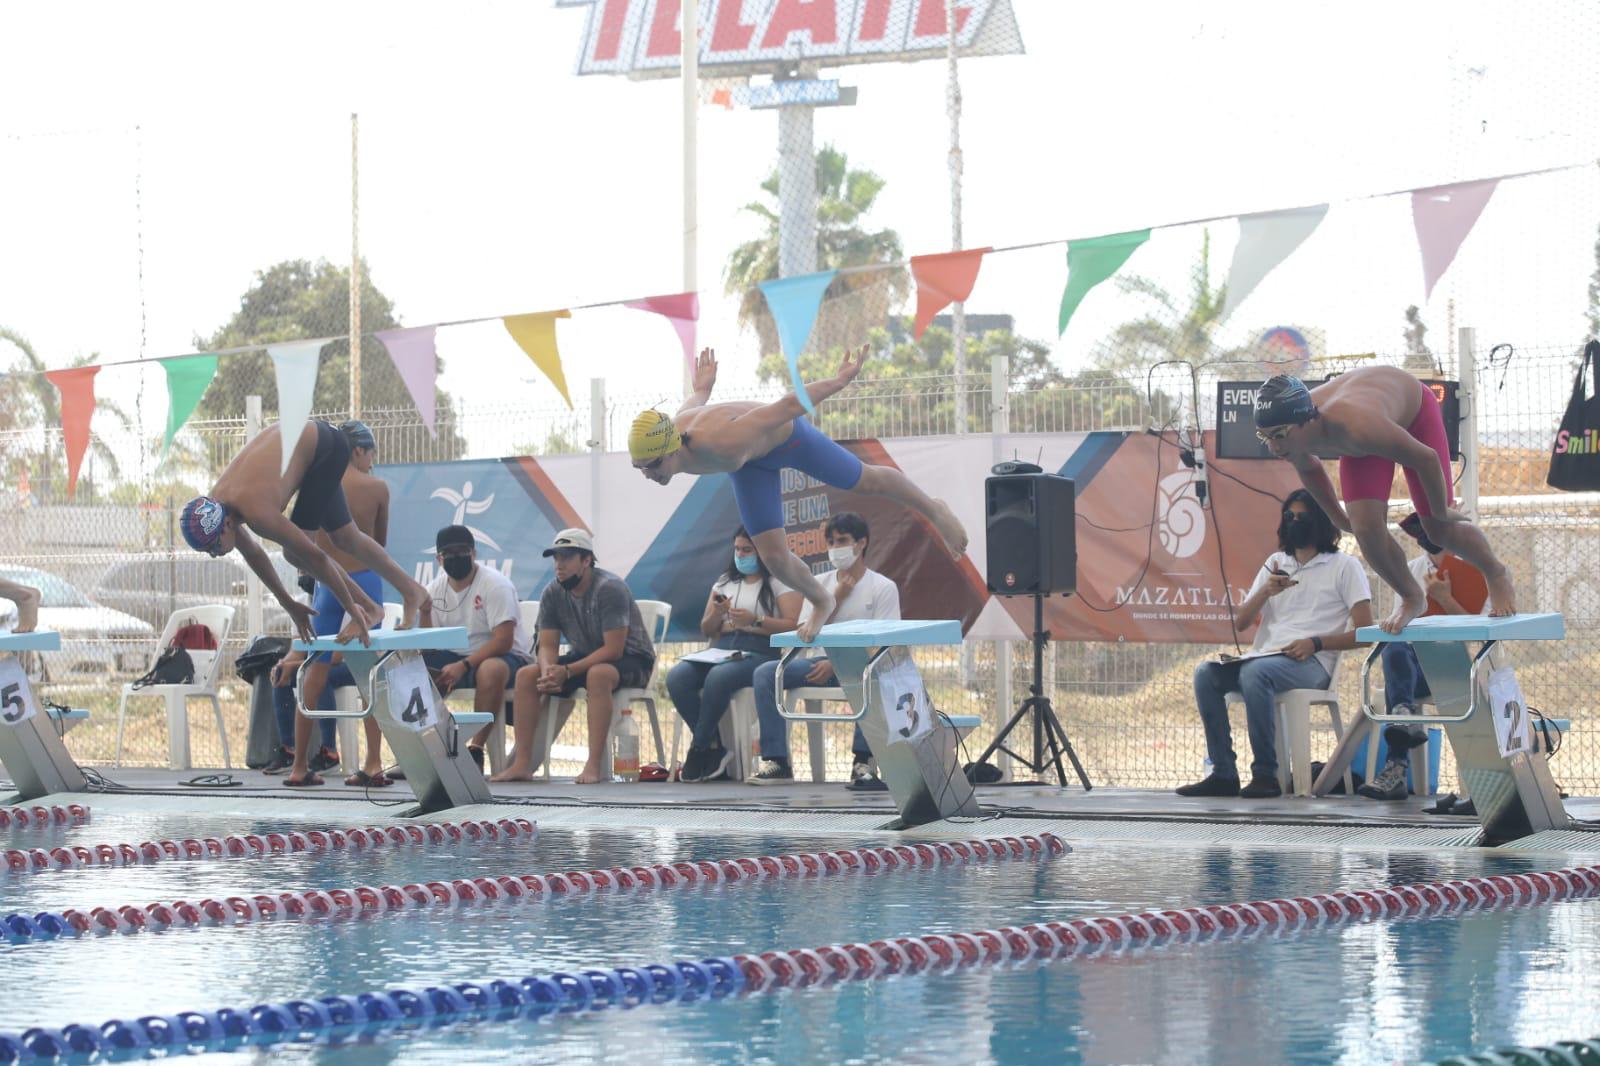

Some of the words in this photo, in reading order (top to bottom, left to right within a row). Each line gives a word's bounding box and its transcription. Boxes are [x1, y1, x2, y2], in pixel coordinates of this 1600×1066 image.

[1223, 389, 1257, 405] EVEN
[1223, 410, 1236, 422] LN
[1556, 429, 1600, 453] Smil
[798, 493, 830, 523] UNA
[1, 682, 25, 722] 5
[402, 686, 428, 727] 4
[896, 693, 919, 738] 3
[1504, 700, 1522, 751] 2
